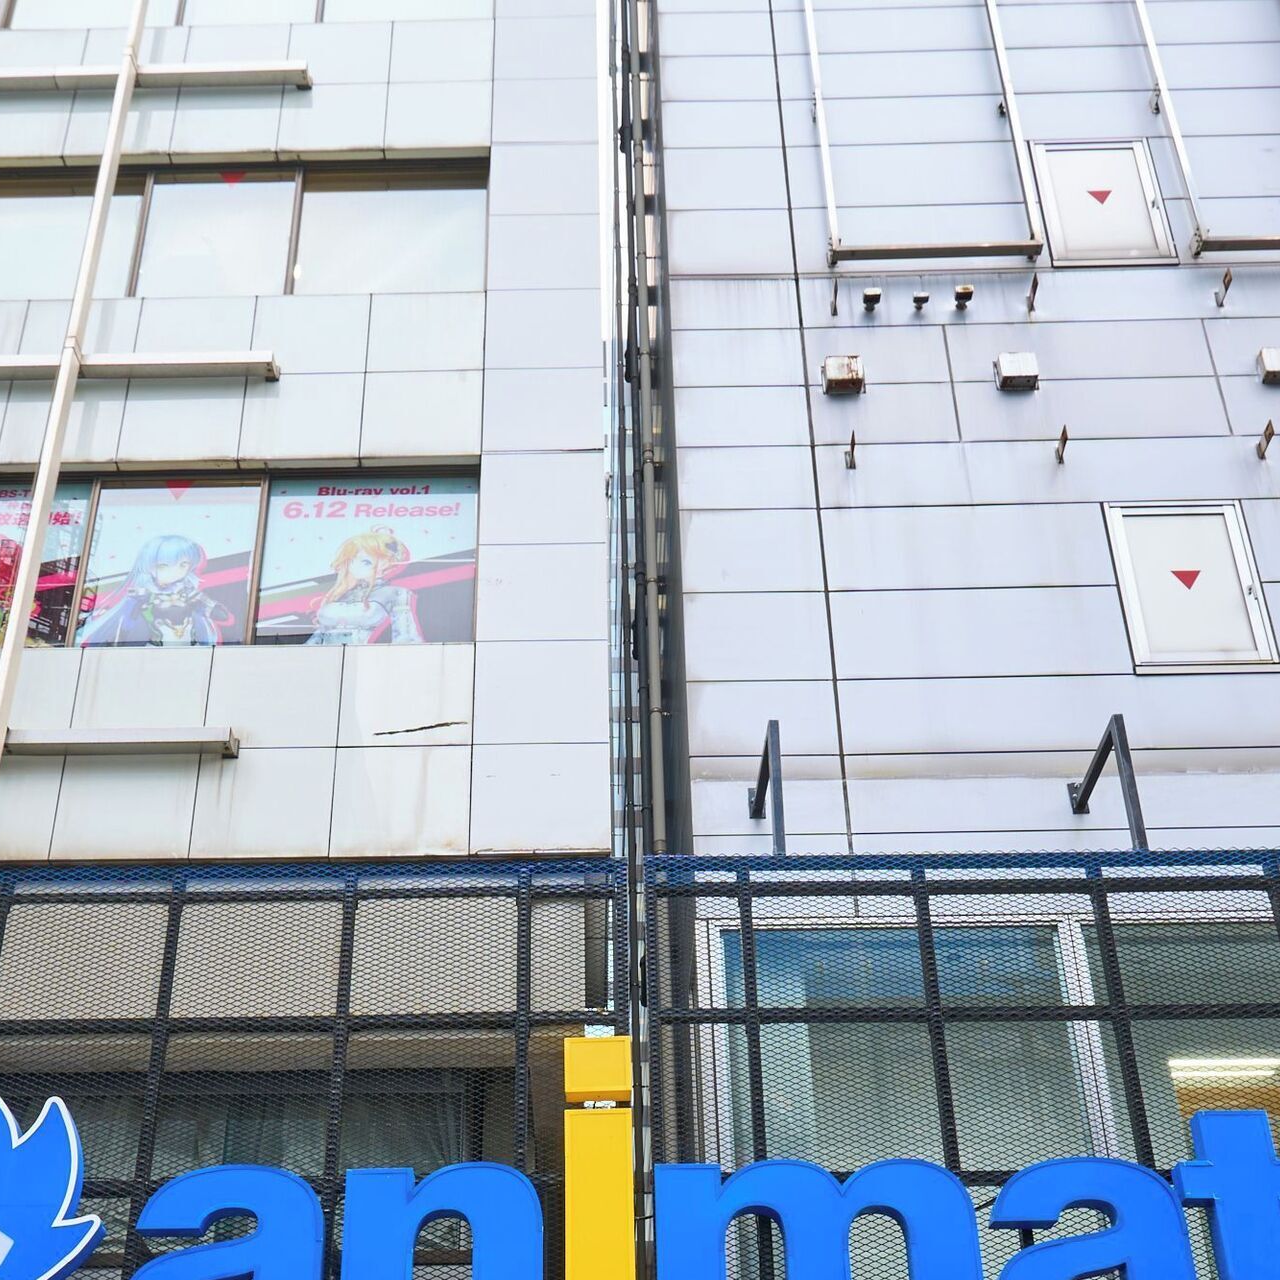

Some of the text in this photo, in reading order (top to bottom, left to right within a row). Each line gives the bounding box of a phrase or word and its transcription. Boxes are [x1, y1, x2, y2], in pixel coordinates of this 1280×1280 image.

[316, 484, 431, 500] Blu-ray vol.1
[283, 500, 462, 520] 6.12 Release!
